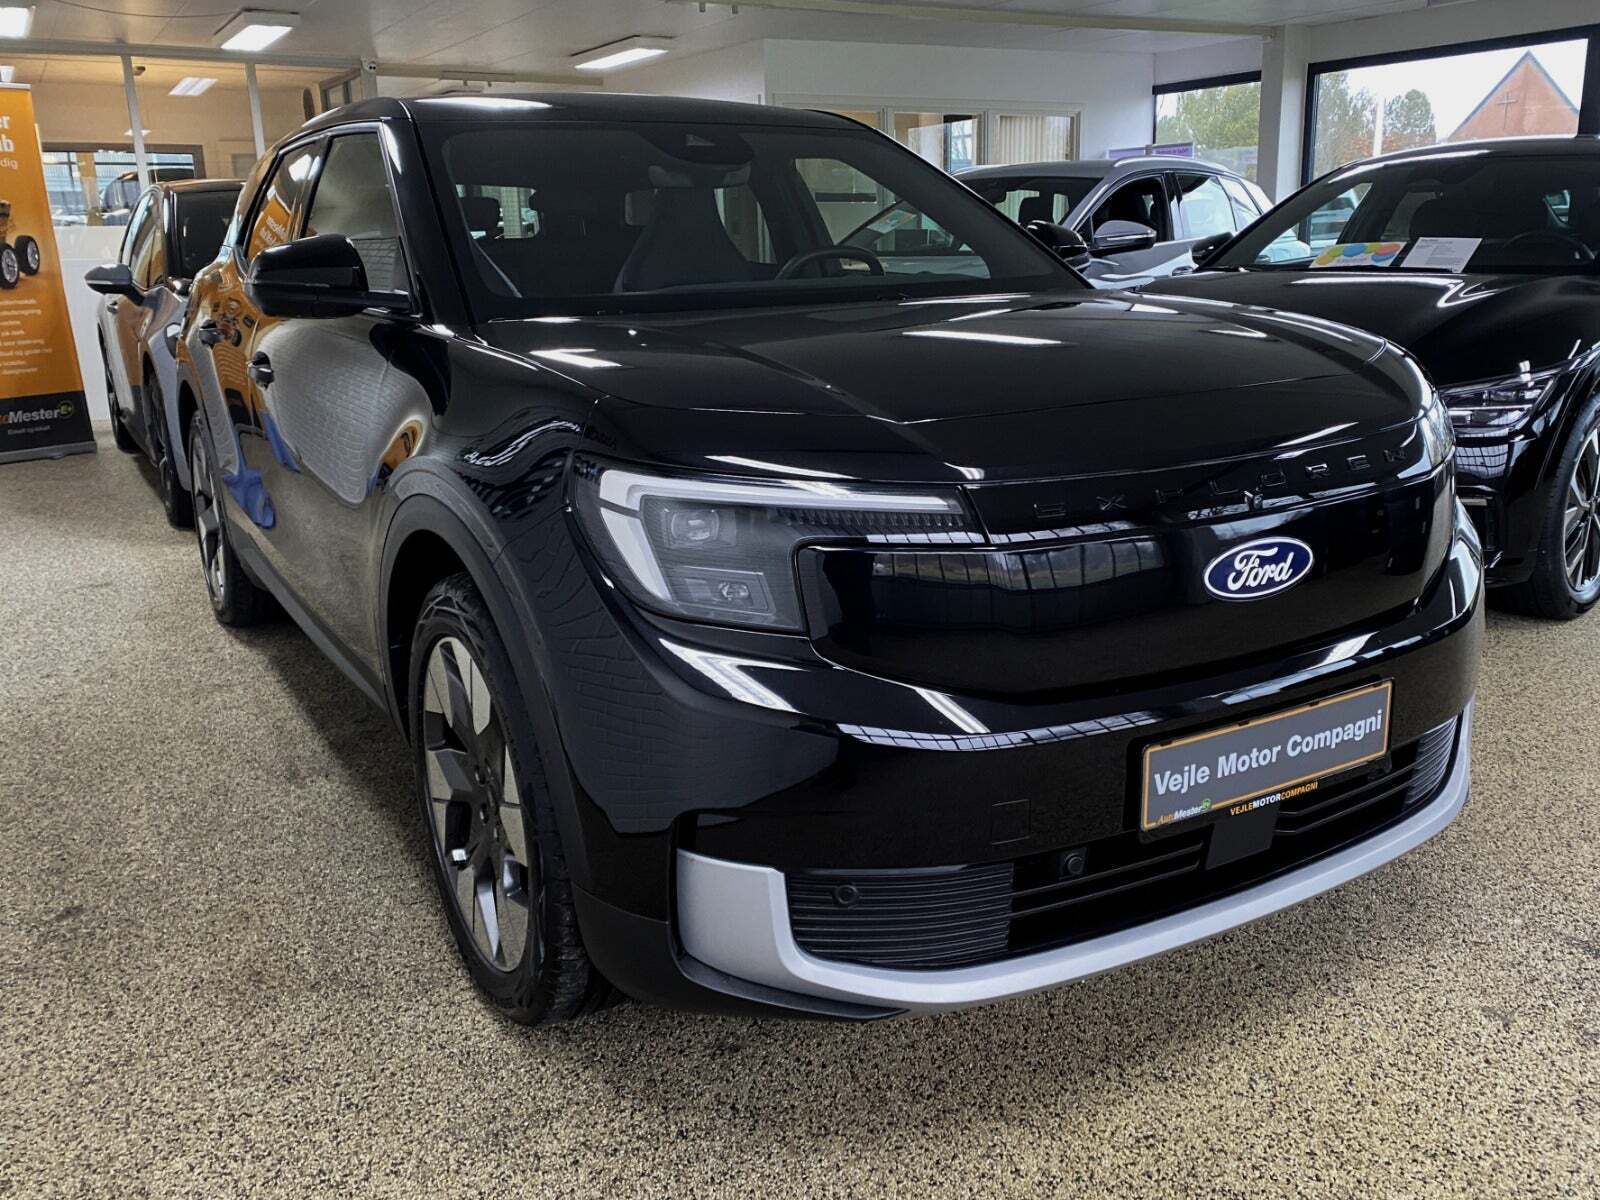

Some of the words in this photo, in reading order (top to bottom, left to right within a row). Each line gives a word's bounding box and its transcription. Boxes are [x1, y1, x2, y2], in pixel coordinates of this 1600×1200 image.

[1227, 546, 1294, 591] Ford
[1154, 764, 1210, 795] Vejle
[1217, 745, 1281, 778] Motor
[1286, 709, 1383, 757] Compagni
